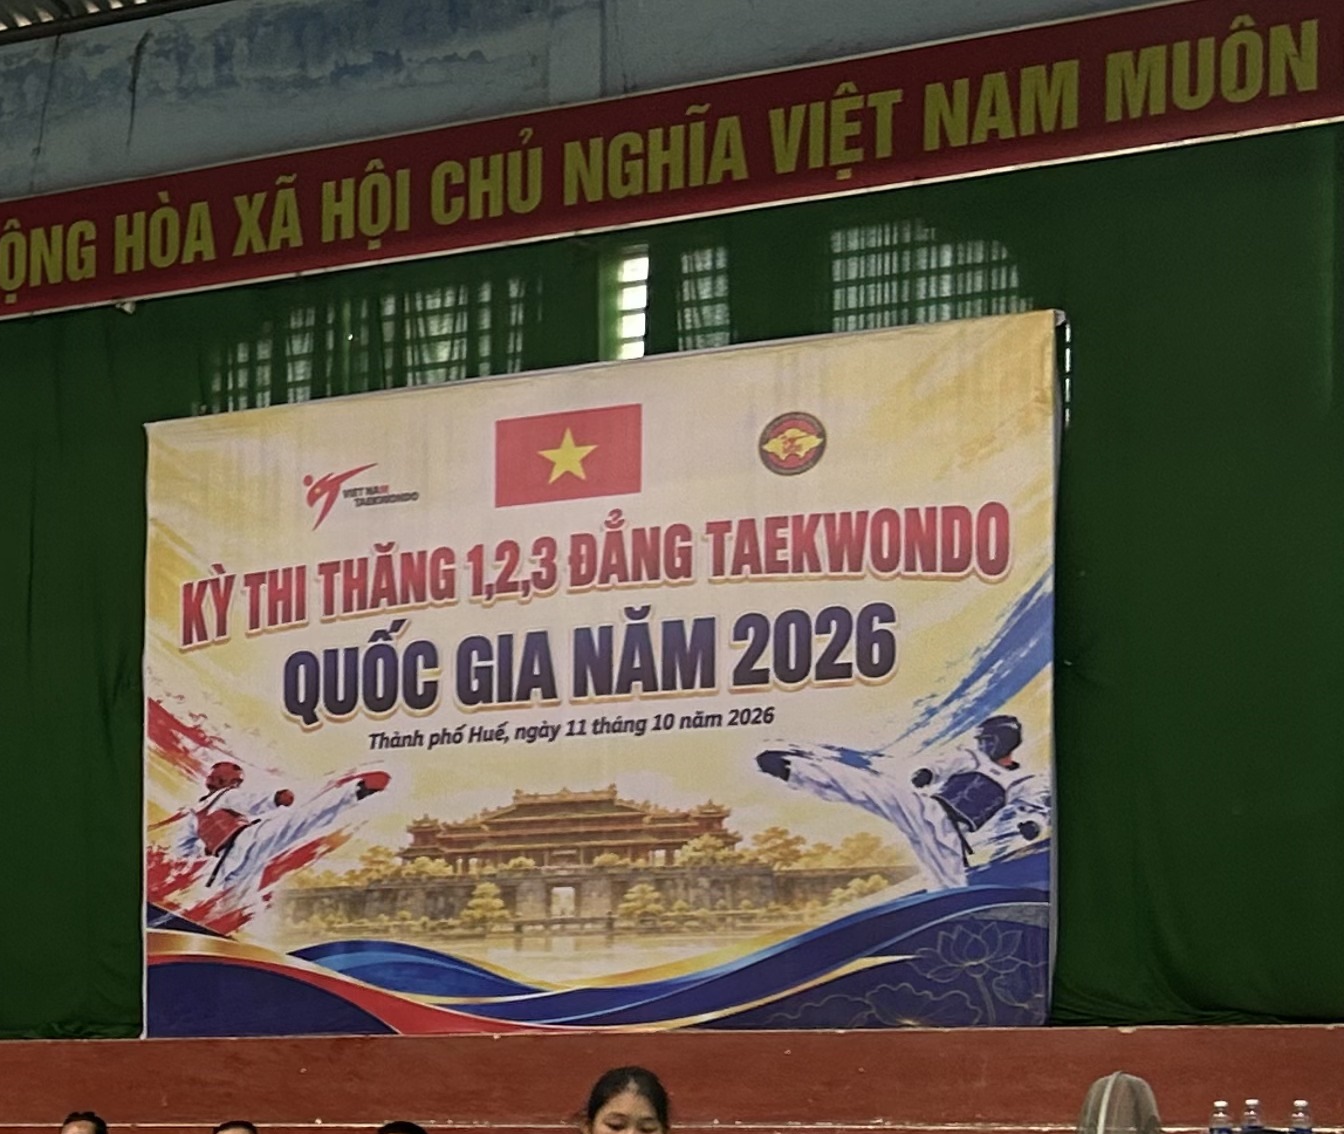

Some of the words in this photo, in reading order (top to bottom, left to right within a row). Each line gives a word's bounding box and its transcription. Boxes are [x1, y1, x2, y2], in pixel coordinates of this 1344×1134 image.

[114, 190, 216, 274] HÒA
[234, 174, 304, 257] XÃ
[321, 158, 411, 250] HỘI
[430, 127, 544, 226] CHỦ
[562, 103, 748, 206] NGHĨA
[768, 81, 904, 181] VIỆT
[922, 59, 1080, 152] NAM
[1105, 15, 1320, 124] MUÔN
[181, 565, 237, 648] KỲ
[246, 571, 306, 628] THI
[319, 538, 456, 615] THĂNG
[466, 537, 559, 606] 1,2,3
[568, 508, 692, 589] ĐẲNG
[705, 501, 1011, 582] TAEKWONDO
[282, 619, 439, 727] QUỐC
[456, 632, 553, 706] GIA
[572, 606, 718, 698] NĂM
[733, 603, 896, 689] 2026
[369, 731, 424, 750] Thành
[427, 724, 466, 750] phố
[468, 722, 510, 746] Huế,
[514, 725, 561, 743] ngày
[565, 719, 587, 737] 11
[591, 715, 648, 740] tháng
[652, 713, 675, 731] 10
[679, 711, 723, 730] năm
[727, 706, 776, 726] 2026
